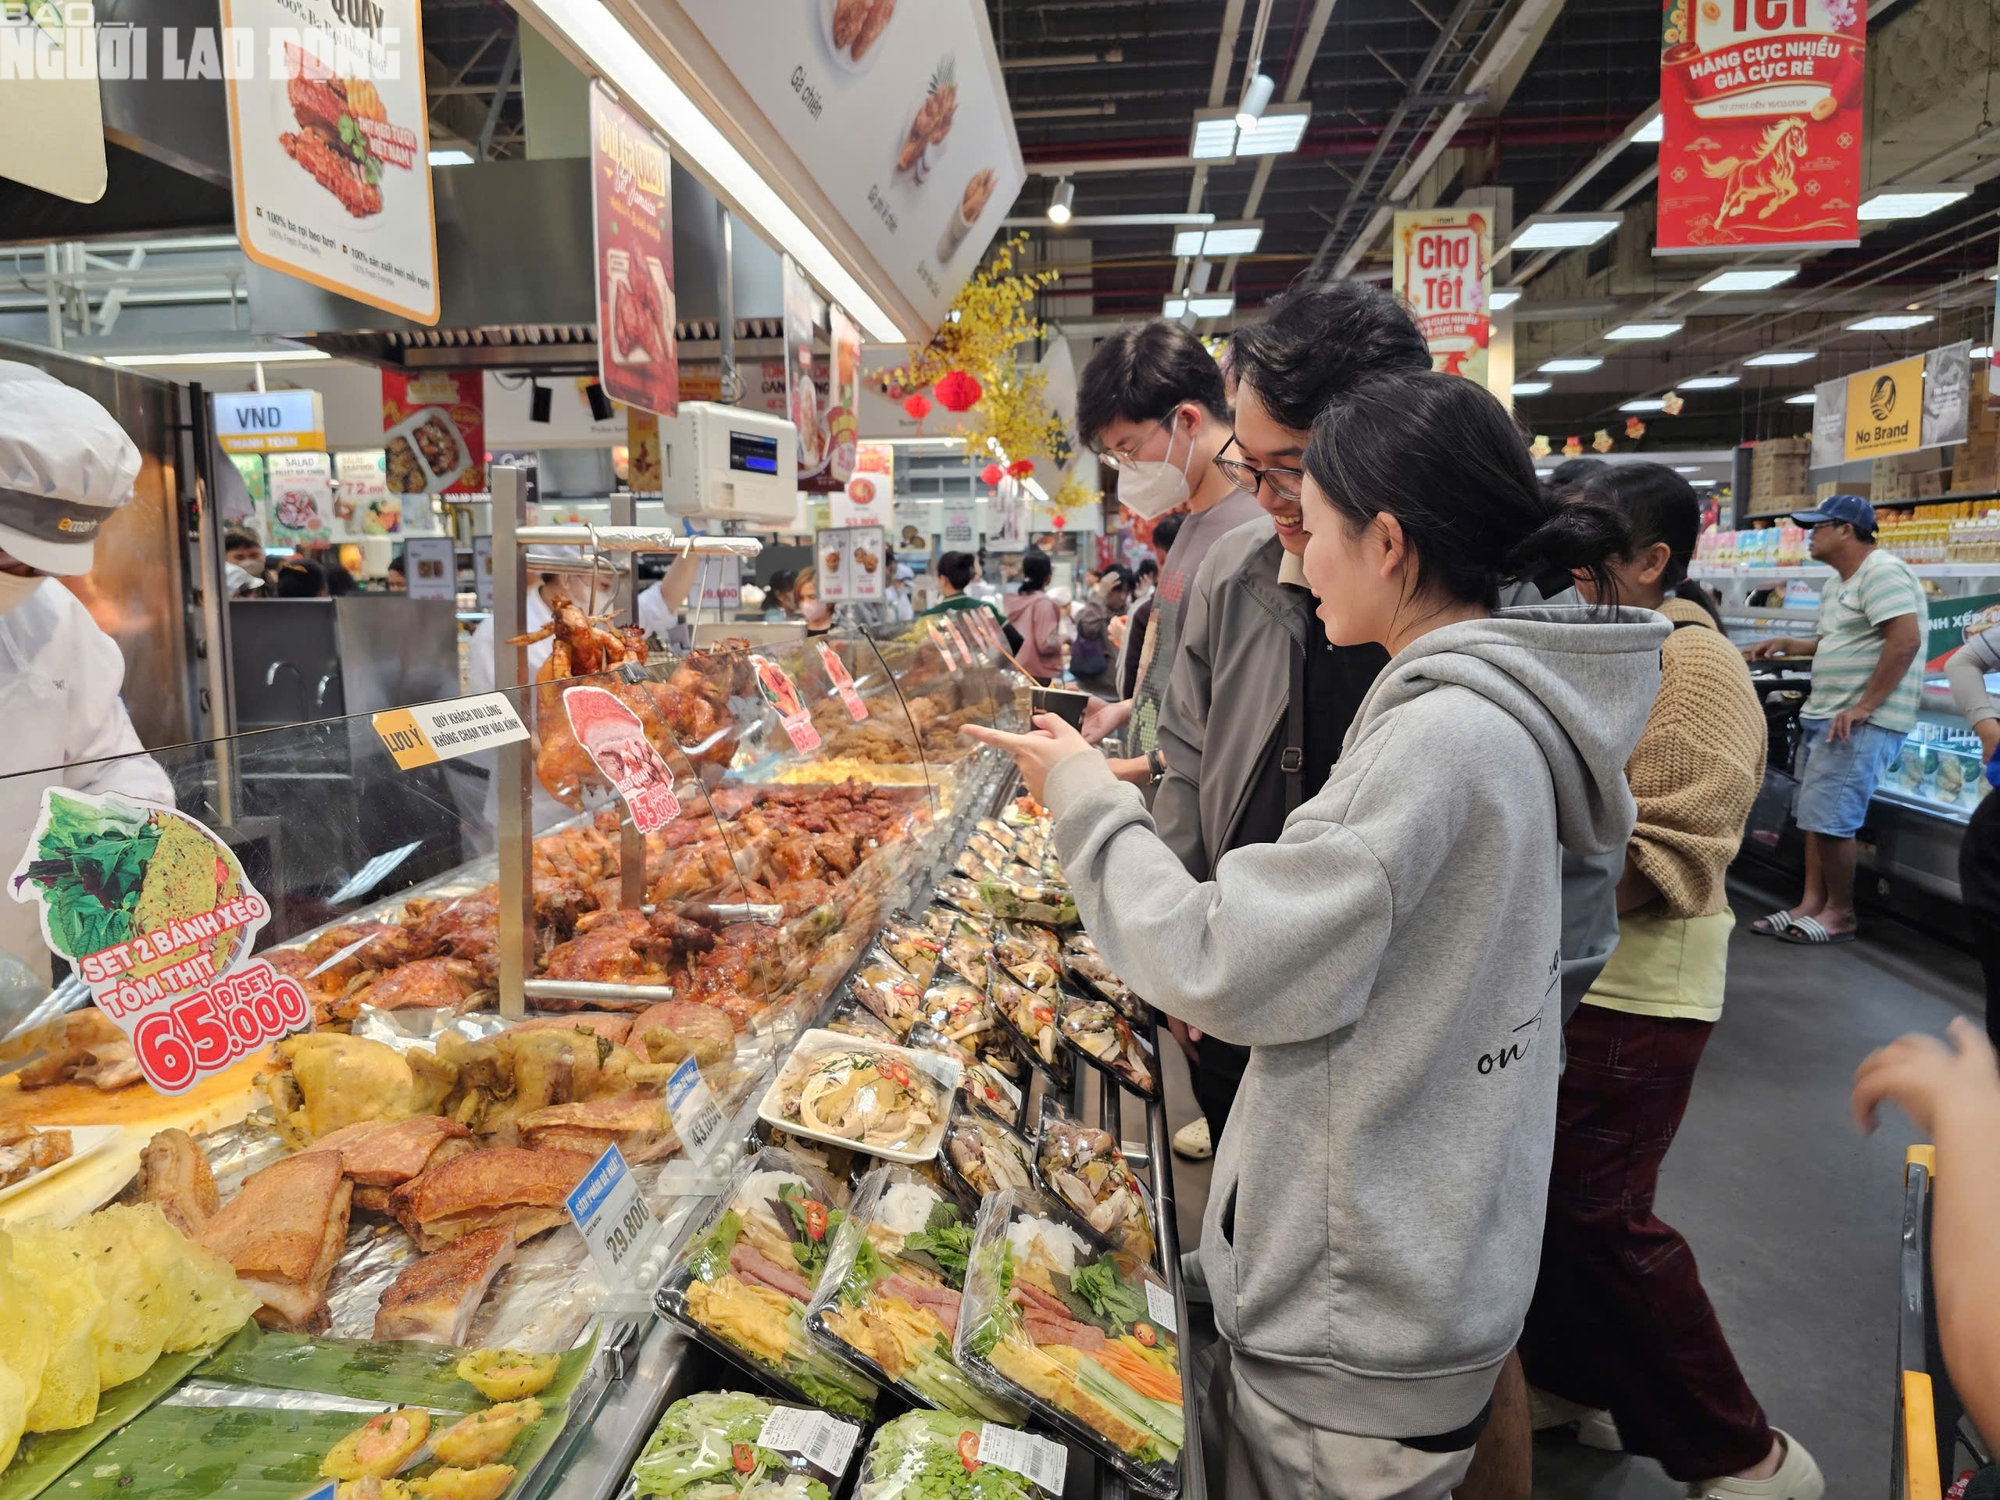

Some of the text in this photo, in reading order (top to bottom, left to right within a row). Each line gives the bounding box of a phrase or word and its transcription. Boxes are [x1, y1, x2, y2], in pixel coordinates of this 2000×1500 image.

[1689, 36, 1841, 80] HÀNG CỰC NHIỀU
[1714, 70, 1747, 89] GIÁ
[267, 211, 286, 228] 100%
[351, 248, 368, 264] 100%
[1418, 234, 1470, 273] Chợ
[1423, 273, 1463, 310] Tết
[236, 407, 281, 429] VND
[1856, 430, 1870, 444] No
[1874, 420, 1909, 440] Brand
[285, 458, 314, 466] SALAD
[58, 517, 98, 533] emart
[449, 708, 474, 724] KHÁCH
[473, 708, 484, 720] VUI
[484, 704, 502, 716] LÒNG
[383, 724, 424, 752] LƯU Ý
[431, 717, 521, 748] KHÔNG CHẠM TAY VÀO KÍNH
[617, 777, 634, 793] HEO
[628, 792, 680, 833] 43.000
[82, 894, 264, 982] SET 2 BÁNH XÈO
[101, 954, 217, 1017] TÔM THỊT
[134, 980, 308, 1090] 65.000
[1477, 1039, 1530, 1074] on
[606, 1197, 650, 1265] 29.800
